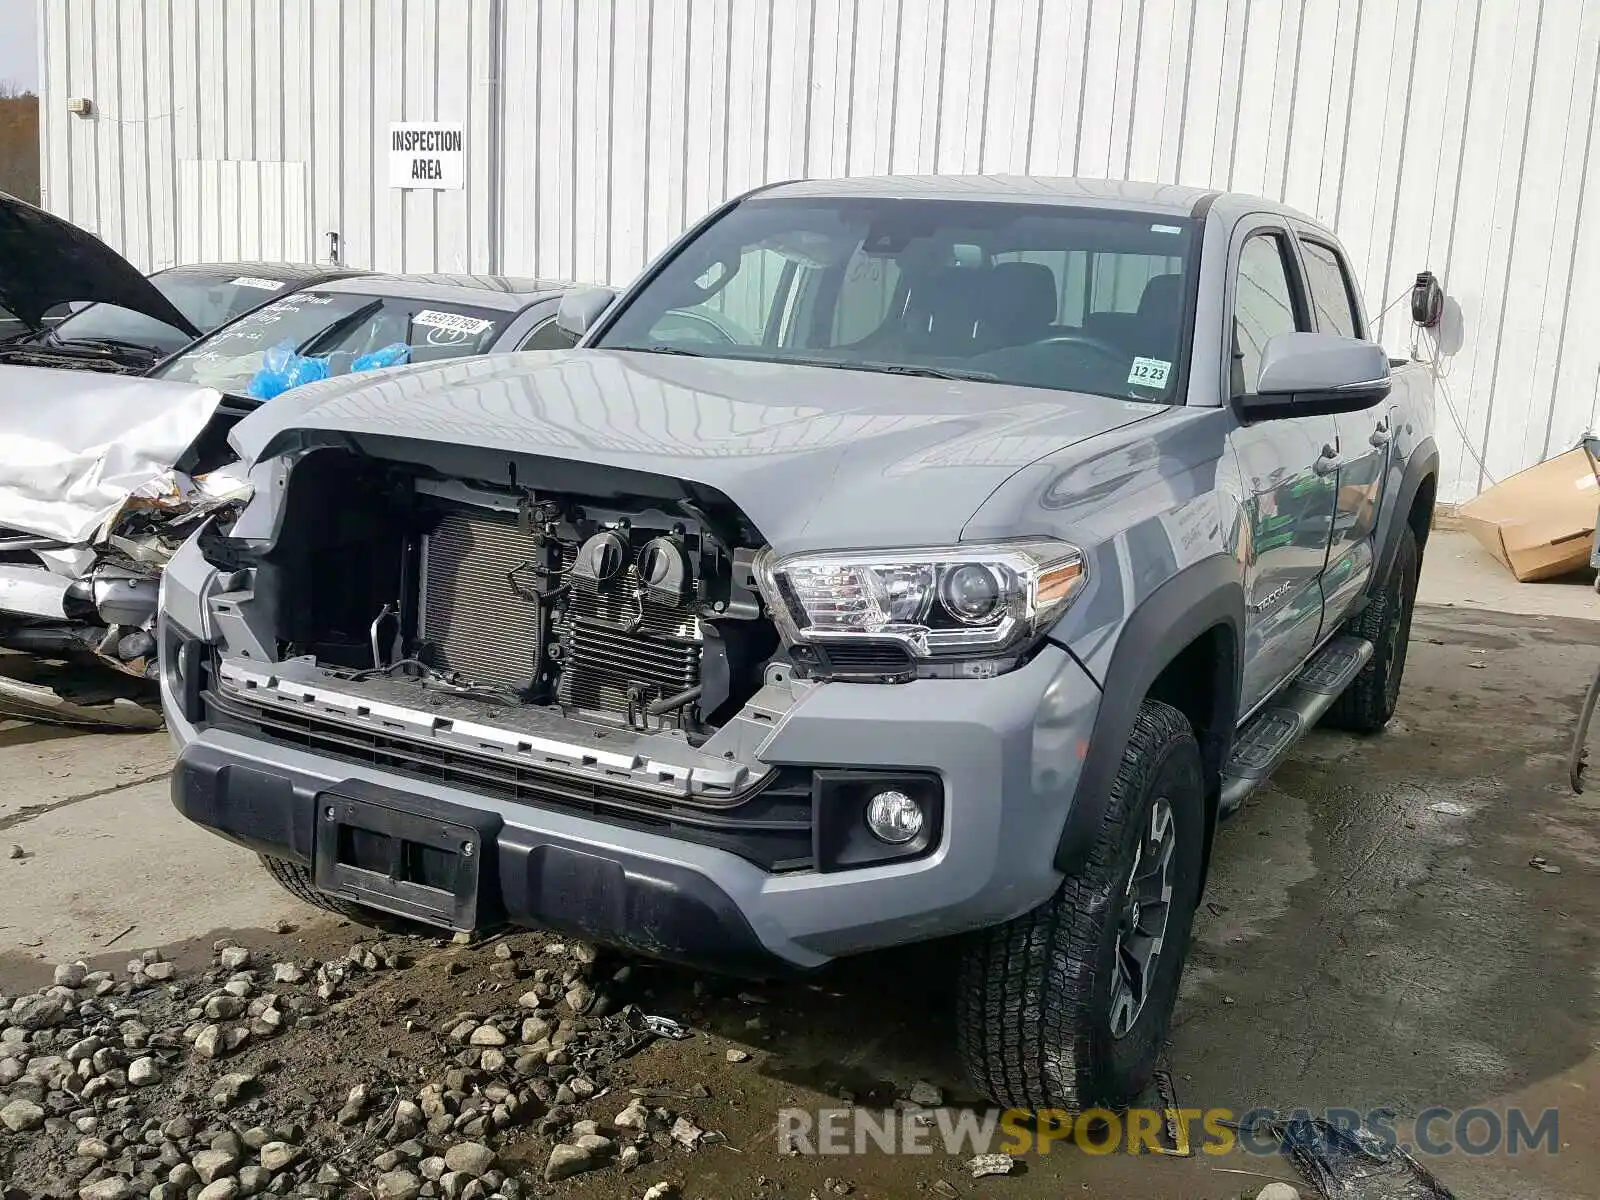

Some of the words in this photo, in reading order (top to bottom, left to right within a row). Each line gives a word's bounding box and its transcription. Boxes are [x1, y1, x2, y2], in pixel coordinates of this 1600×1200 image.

[392, 131, 462, 152] INSPECTION
[412, 159, 442, 180] AREA
[1133, 366, 1148, 377] 12
[1150, 367, 1164, 380] 23
